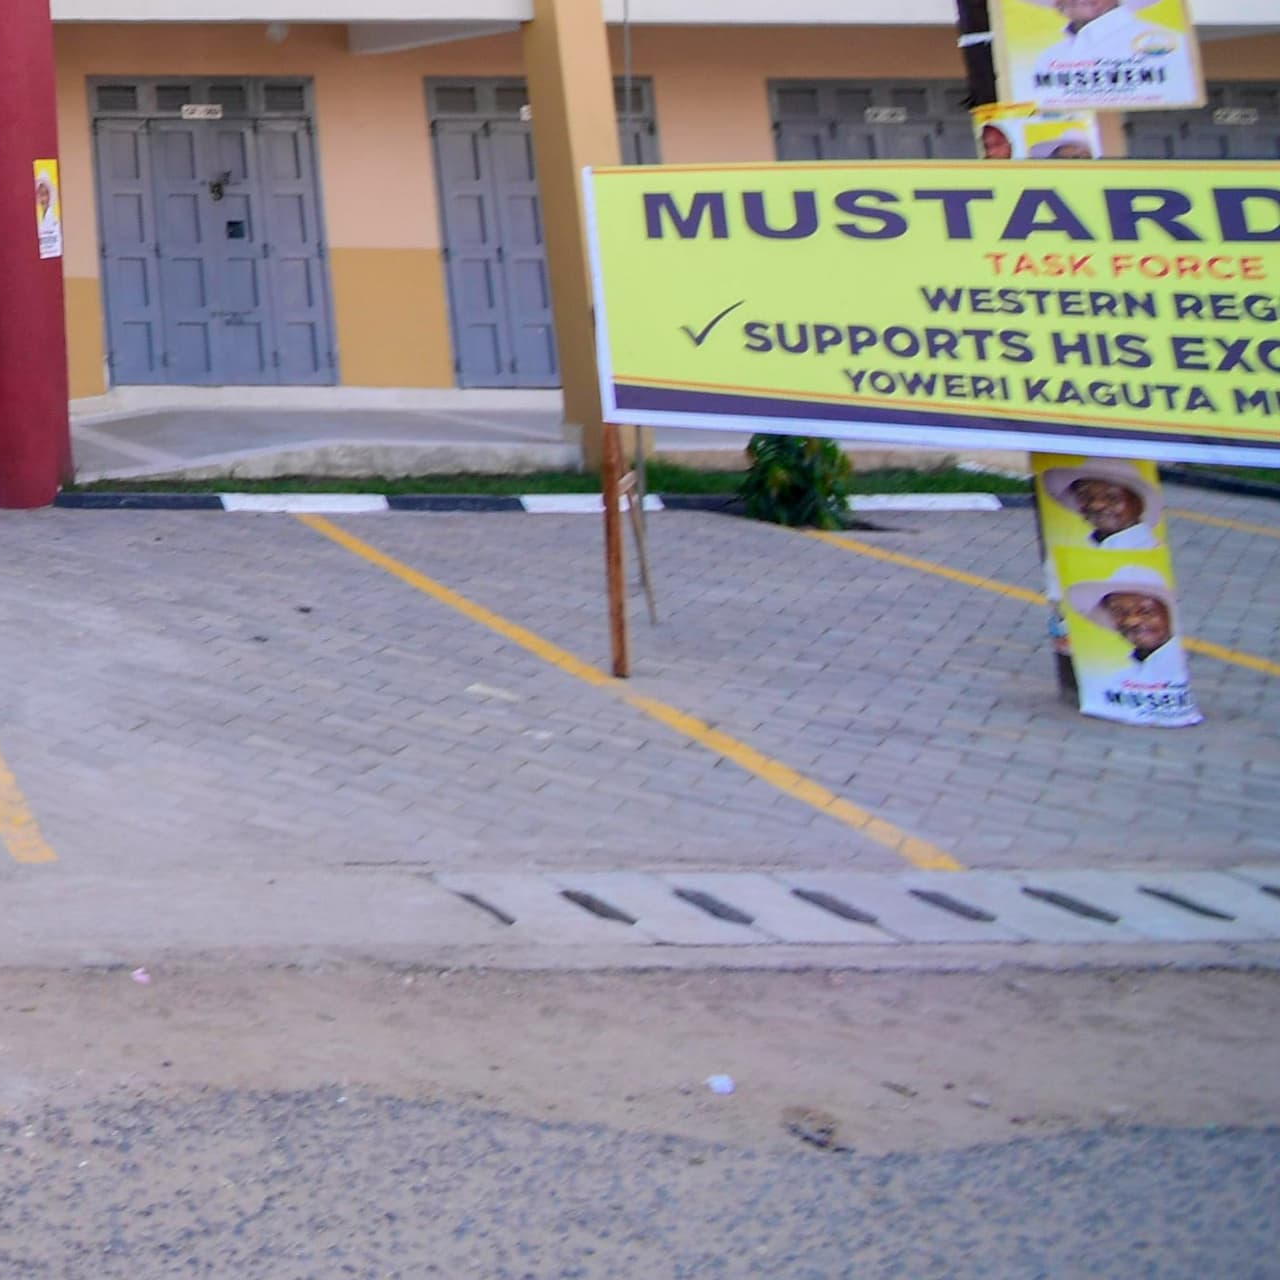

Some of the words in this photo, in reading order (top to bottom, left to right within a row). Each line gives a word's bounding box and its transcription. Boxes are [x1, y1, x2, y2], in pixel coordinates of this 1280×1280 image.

[642, 188, 1280, 242] MUSTARD
[984, 252, 1095, 277] TASK
[1110, 254, 1267, 280] FORCE
[920, 286, 1158, 319] WESTERN
[743, 321, 1035, 362] SUPPORTS
[1051, 332, 1153, 369] HIS
[842, 368, 1010, 401] YOWERI
[1024, 377, 1218, 413] KAGUTA
